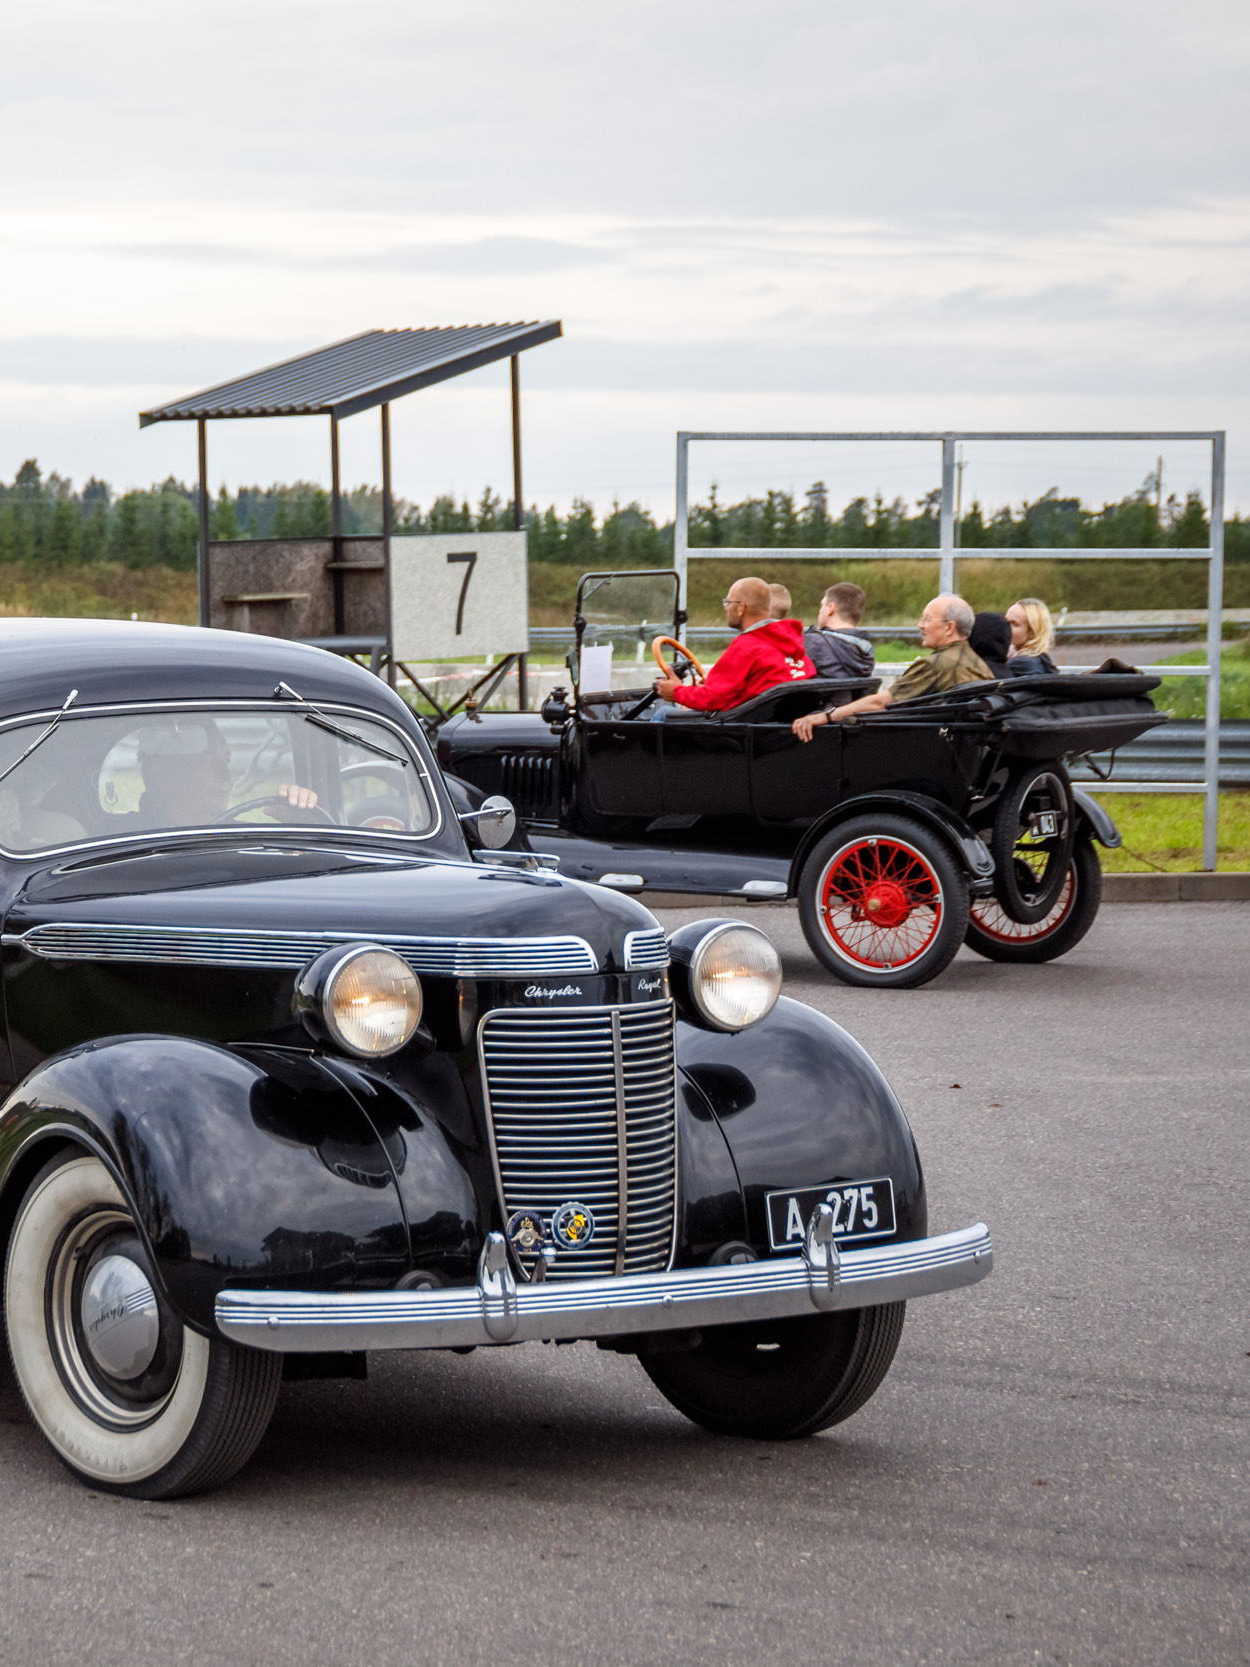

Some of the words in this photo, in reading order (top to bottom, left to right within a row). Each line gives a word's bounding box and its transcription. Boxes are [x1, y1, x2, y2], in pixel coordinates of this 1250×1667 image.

[447, 551, 478, 636] 7
[524, 984, 583, 1000] Chrysler
[637, 978, 661, 993] Royal
[785, 1196, 806, 1242] A
[825, 1185, 879, 1234] 275
